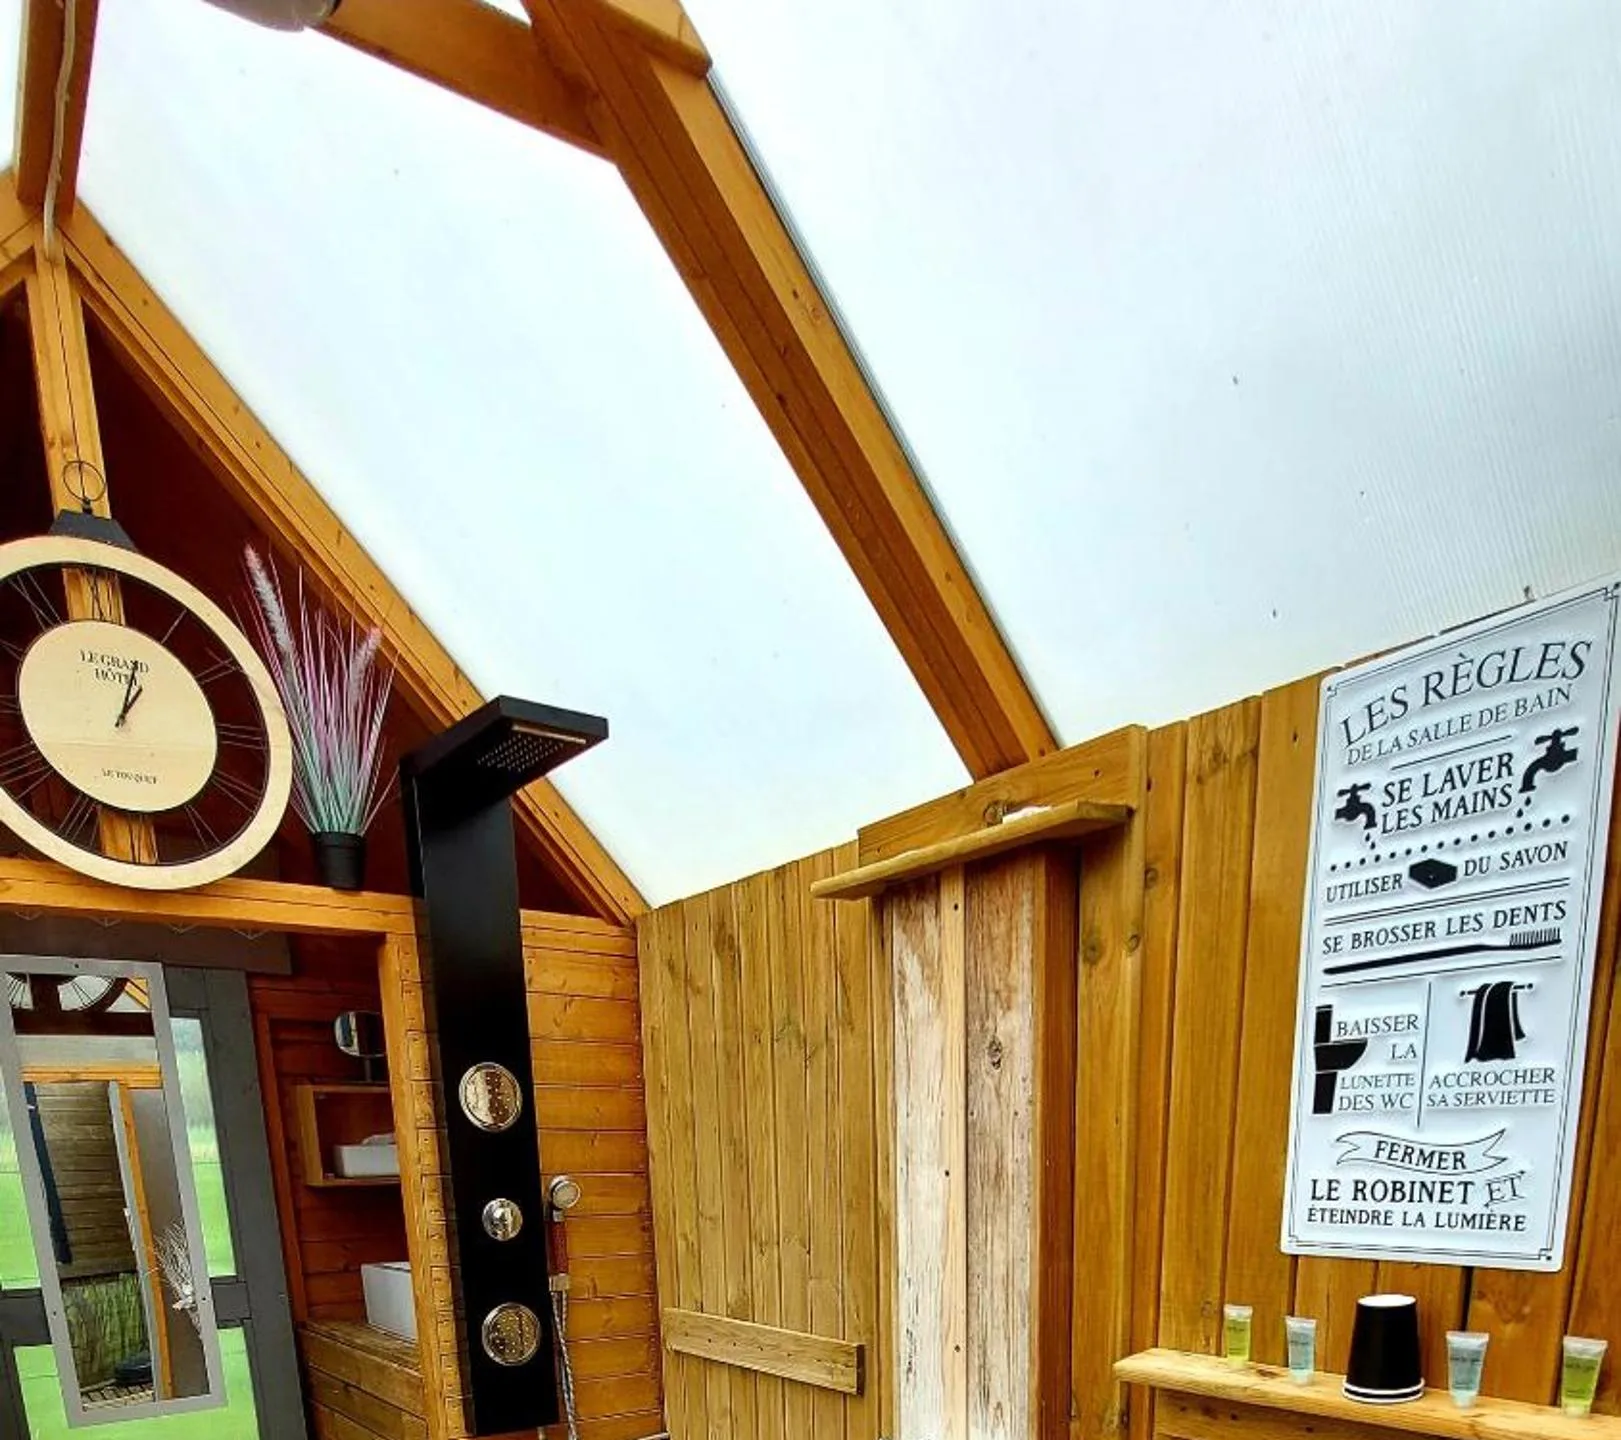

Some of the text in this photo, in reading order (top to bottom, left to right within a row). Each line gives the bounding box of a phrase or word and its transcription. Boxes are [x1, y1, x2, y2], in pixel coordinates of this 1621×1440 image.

[1339, 640, 1593, 749] LES RÈGLES
[1346, 683, 1573, 766] DE LA SALLE DE BAIN
[1381, 751, 1515, 808] SE LAVER
[1380, 783, 1514, 835] LES MAINS
[1325, 840, 1569, 903] UTILISER DU SAVON
[1322, 900, 1568, 955] SE BROSSER LES DENTS
[1336, 1013, 1419, 1038] BAISSER
[1389, 1042, 1418, 1060] LA
[1340, 1072, 1416, 1090] LUNETTE
[1428, 1066, 1556, 1090] ACCROCHER
[1337, 1091, 1414, 1111] DES WC
[1426, 1088, 1556, 1108] SA SERVIETTE
[1374, 1139, 1468, 1171] FERMER
[1310, 1174, 1524, 1205] LE ROBINET ET
[1306, 1203, 1528, 1232] ÉTEINDRE LA LUMIÈRE
